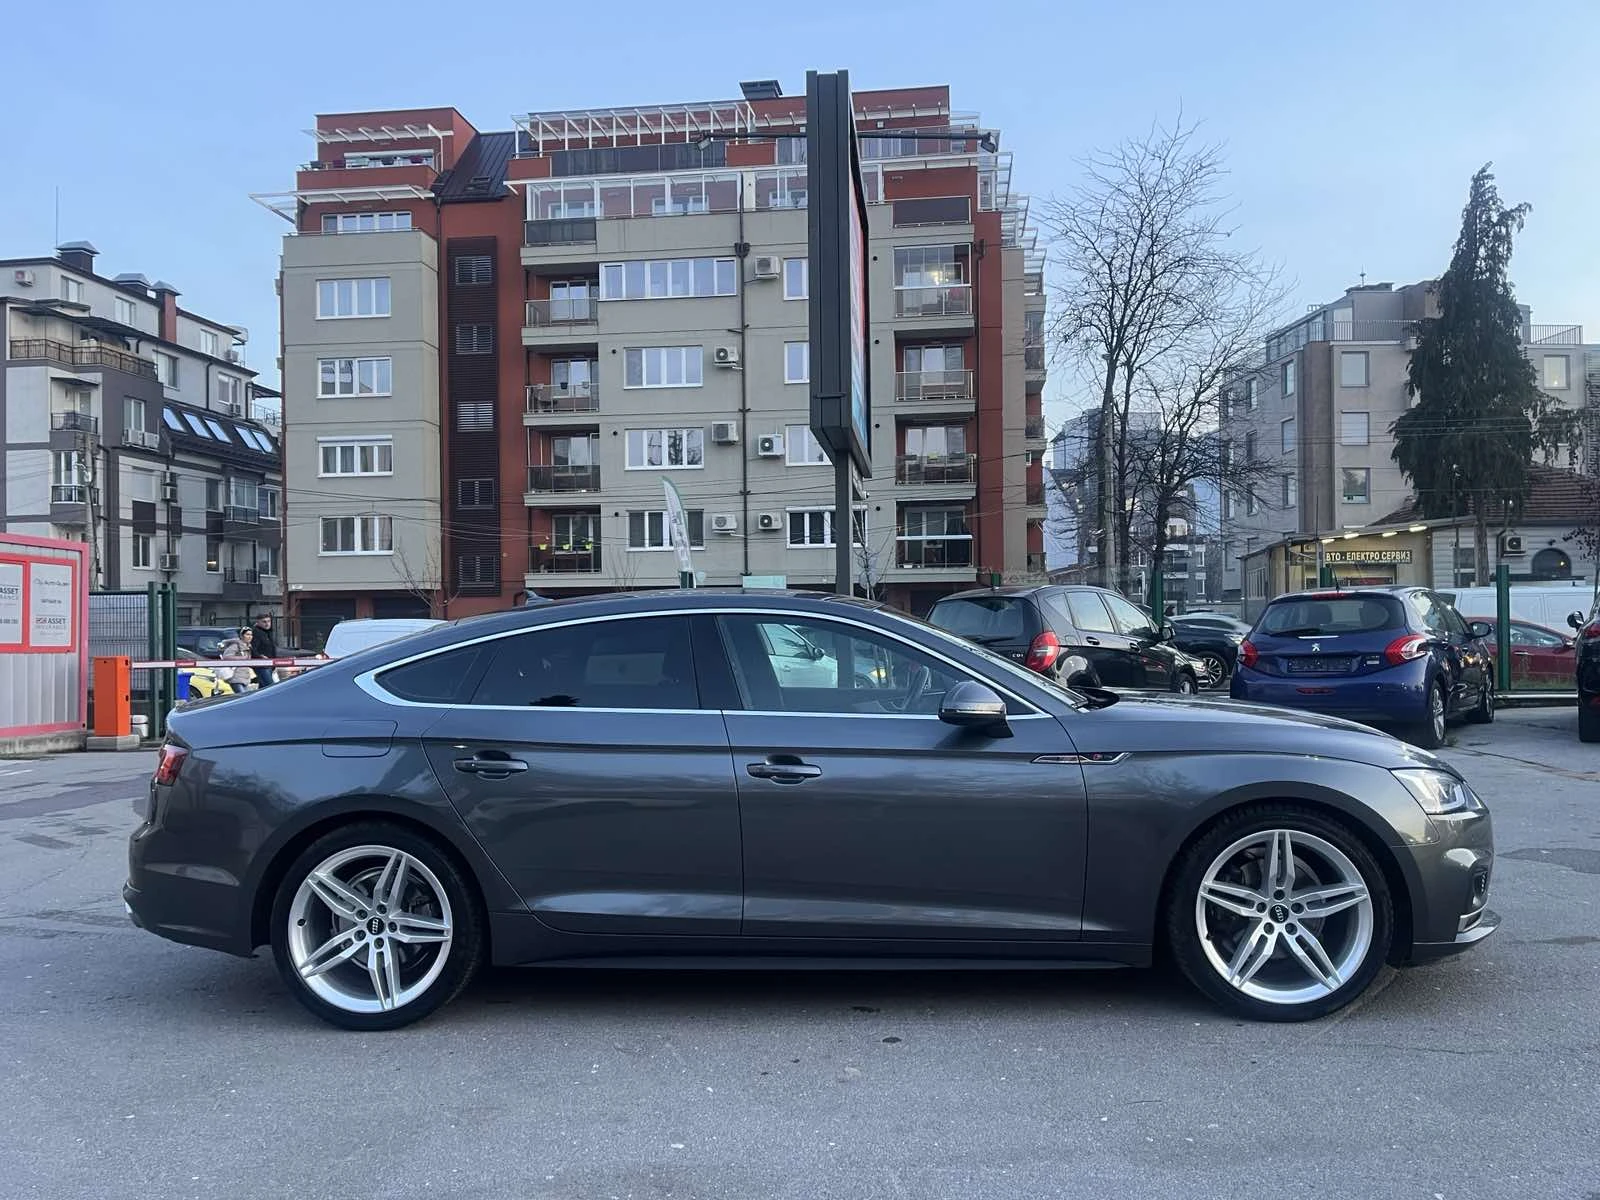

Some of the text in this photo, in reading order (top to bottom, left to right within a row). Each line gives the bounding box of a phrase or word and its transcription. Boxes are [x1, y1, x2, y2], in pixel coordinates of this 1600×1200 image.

[1325, 552, 1341, 562] ВТО
[1346, 552, 1380, 561] ЕЛЕКТРО
[1381, 551, 1410, 561] СЕРВИЗ
